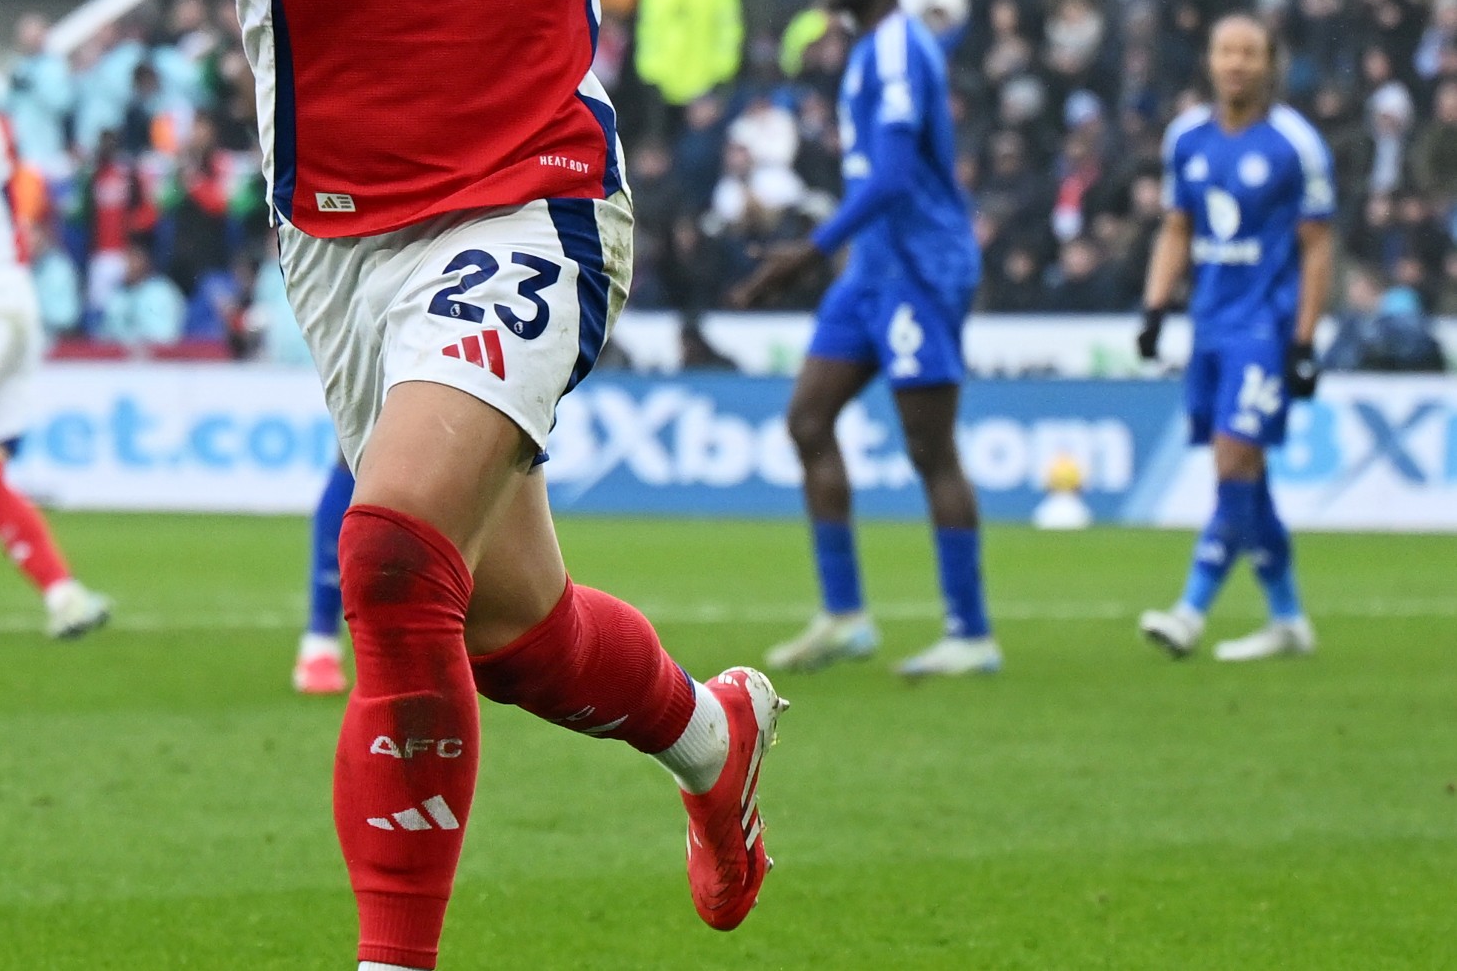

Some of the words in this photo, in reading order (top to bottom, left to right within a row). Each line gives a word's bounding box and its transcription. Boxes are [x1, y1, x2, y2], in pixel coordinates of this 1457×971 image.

[539, 155, 589, 174] HEAT.RDY
[427, 248, 562, 341] 23
[888, 302, 925, 356] 6
[369, 735, 463, 758] AFC
